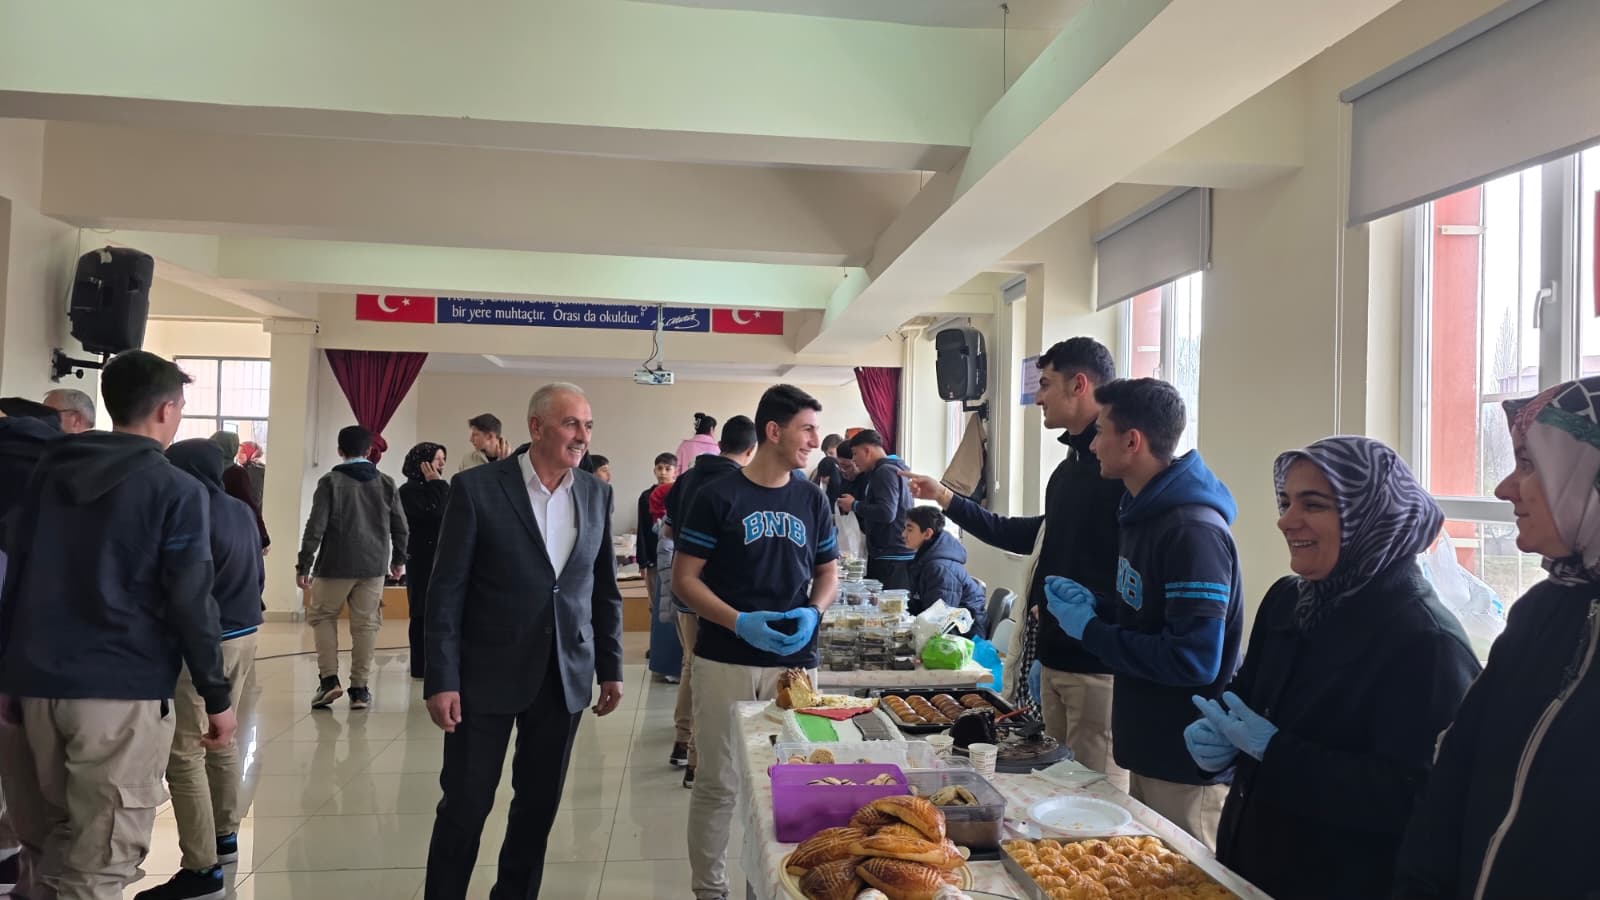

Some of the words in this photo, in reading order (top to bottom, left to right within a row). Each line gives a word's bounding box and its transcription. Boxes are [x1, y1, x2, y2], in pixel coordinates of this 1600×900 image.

[452, 304, 466, 318] bir
[469, 308, 492, 323] yere
[495, 306, 546, 324] muhtaçtır.
[553, 308, 580, 321] Orası
[584, 309, 596, 322] da
[742, 511, 806, 547] BNB
